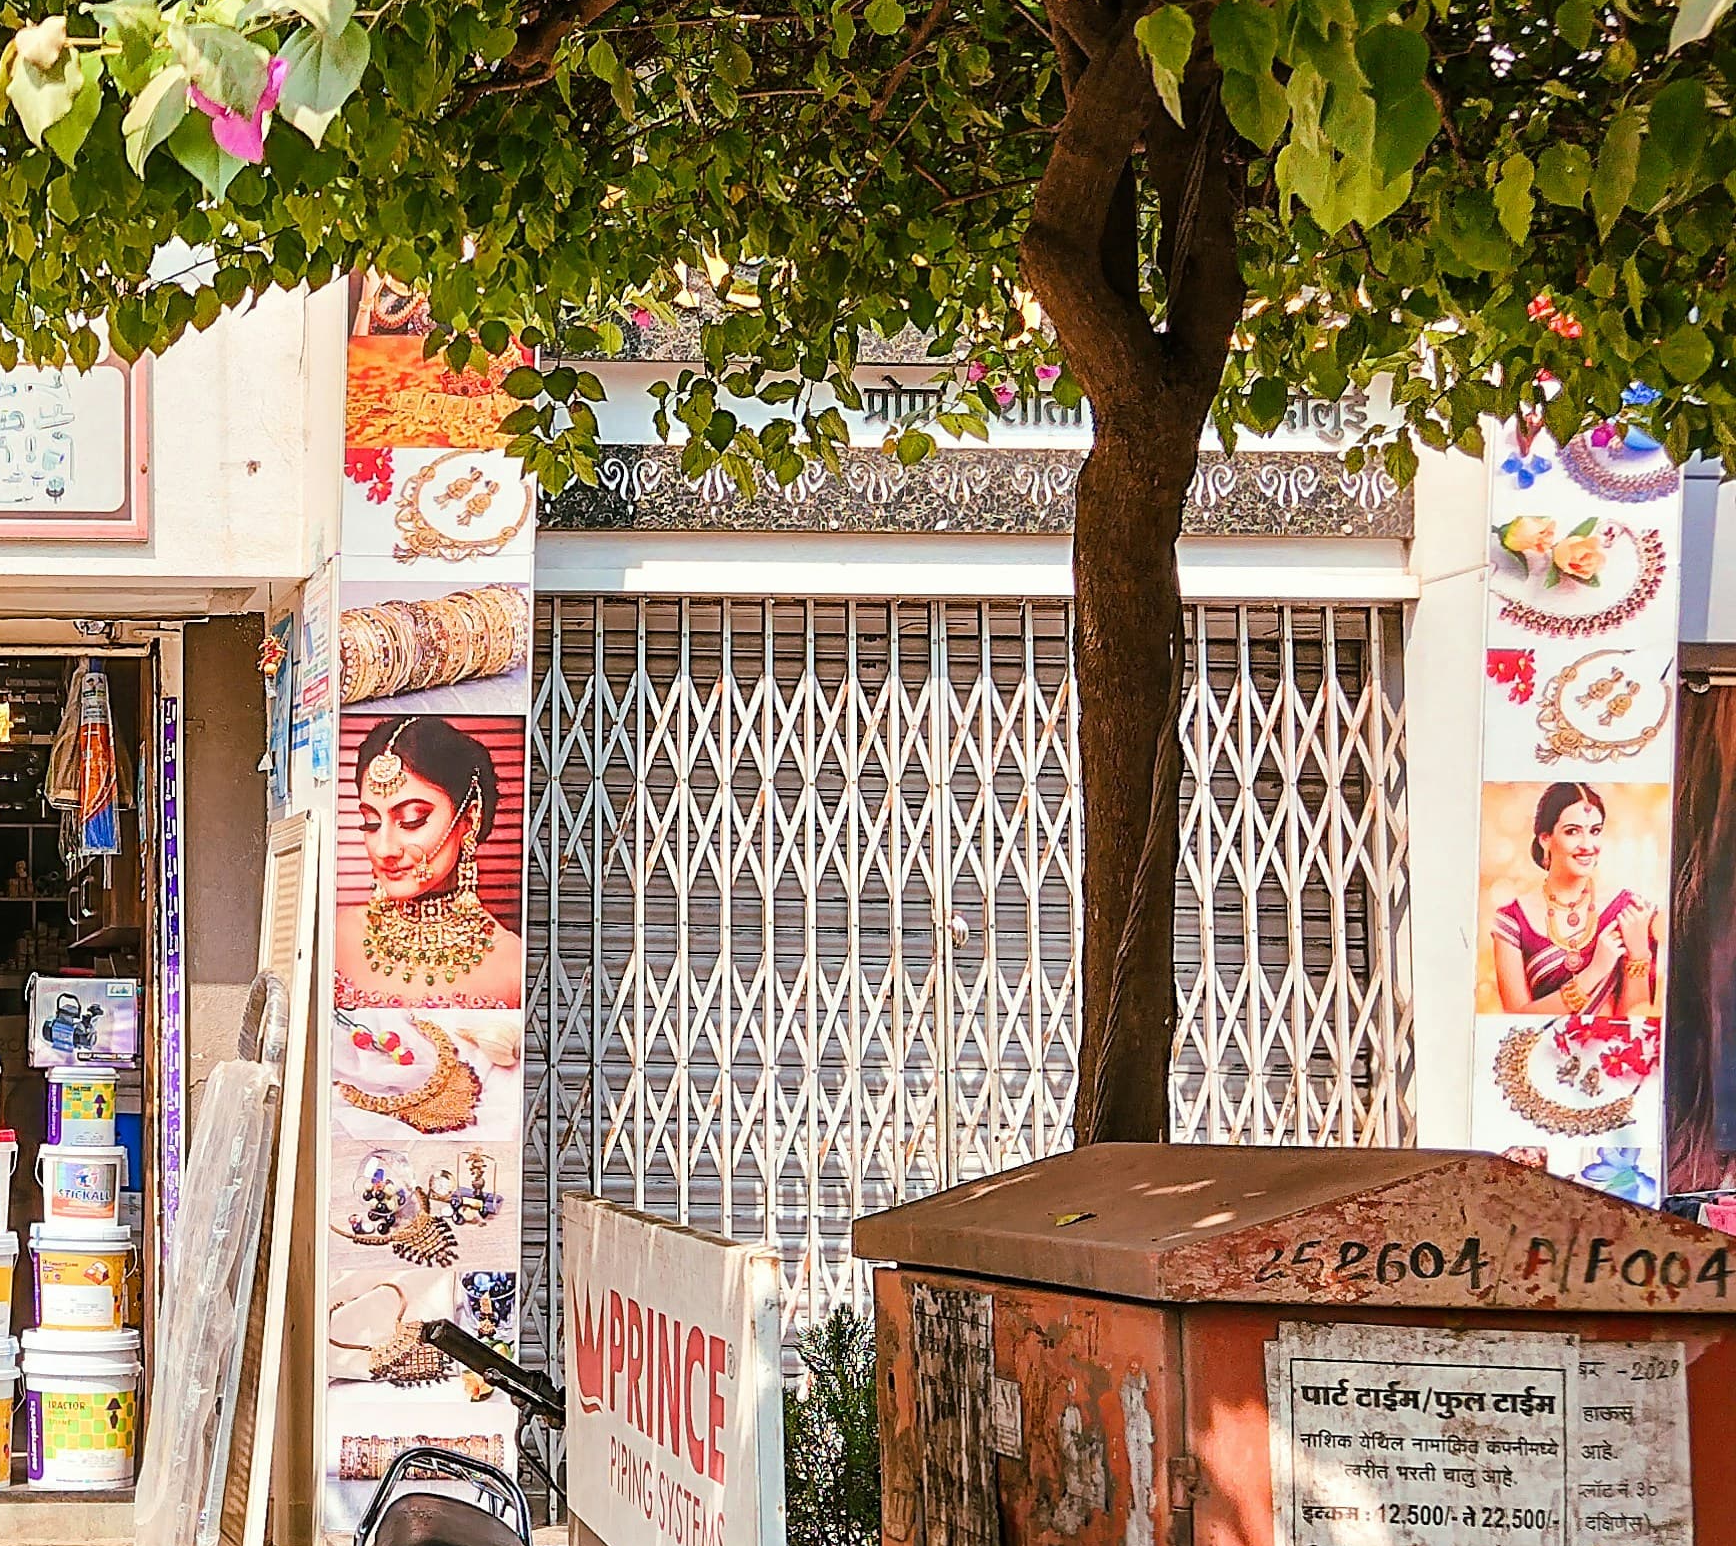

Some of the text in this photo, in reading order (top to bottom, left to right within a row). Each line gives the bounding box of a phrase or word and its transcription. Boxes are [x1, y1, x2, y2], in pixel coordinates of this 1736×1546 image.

[58, 1189, 111, 1201] STICKALL
[609, 1288, 725, 1486] PRINCE
[1301, 1378, 1349, 1406] पार्ट
[1492, 1386, 1556, 1417] टाईम
[1300, 1429, 1352, 1449] नाशिक
[1486, 1437, 1559, 1458] कंपनीमध्ये
[610, 1435, 653, 1520] PIPING
[1344, 1459, 1389, 1479] त्वरीत
[1397, 1461, 1436, 1483] भरती
[1443, 1469, 1475, 1487] चालु
[1377, 1503, 1458, 1527] 12,500/-
[1462, 1505, 1476, 1527] ते
[1482, 1505, 1559, 1531] 22,500/-
